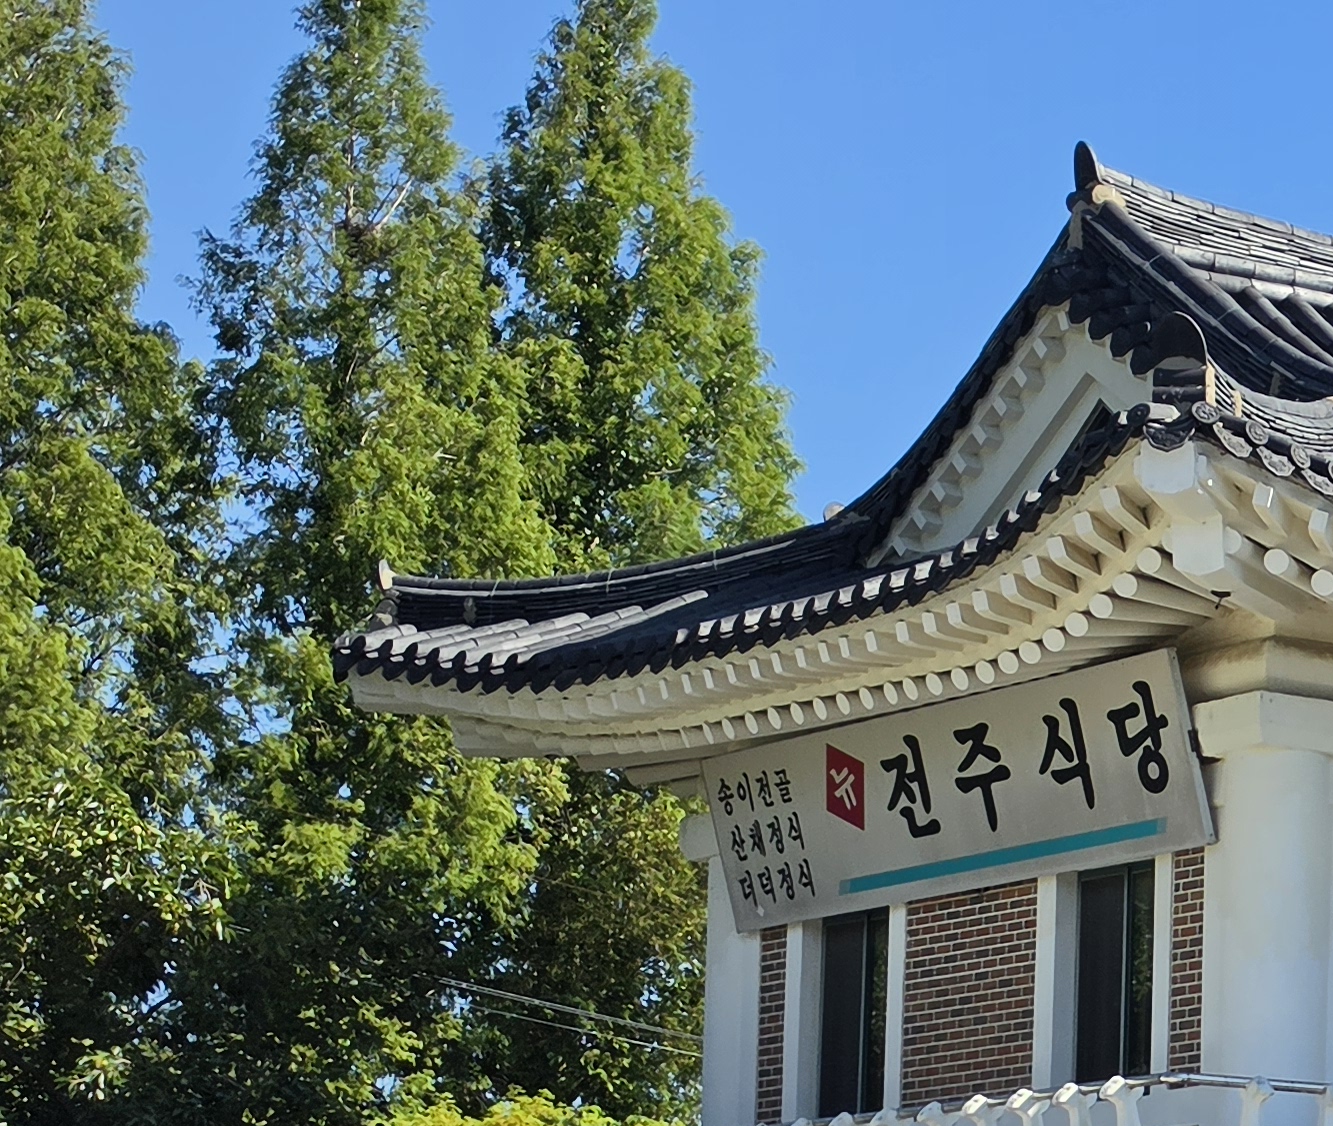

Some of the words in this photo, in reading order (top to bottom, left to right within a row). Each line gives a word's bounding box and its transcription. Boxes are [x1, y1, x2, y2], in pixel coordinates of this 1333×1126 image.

[830, 766, 858, 813] 뉴
[880, 680, 1170, 839] 전주식당
[717, 768, 793, 816] 송이전골
[731, 811, 805, 862] 산채정식
[738, 858, 816, 908] 더덕정식
